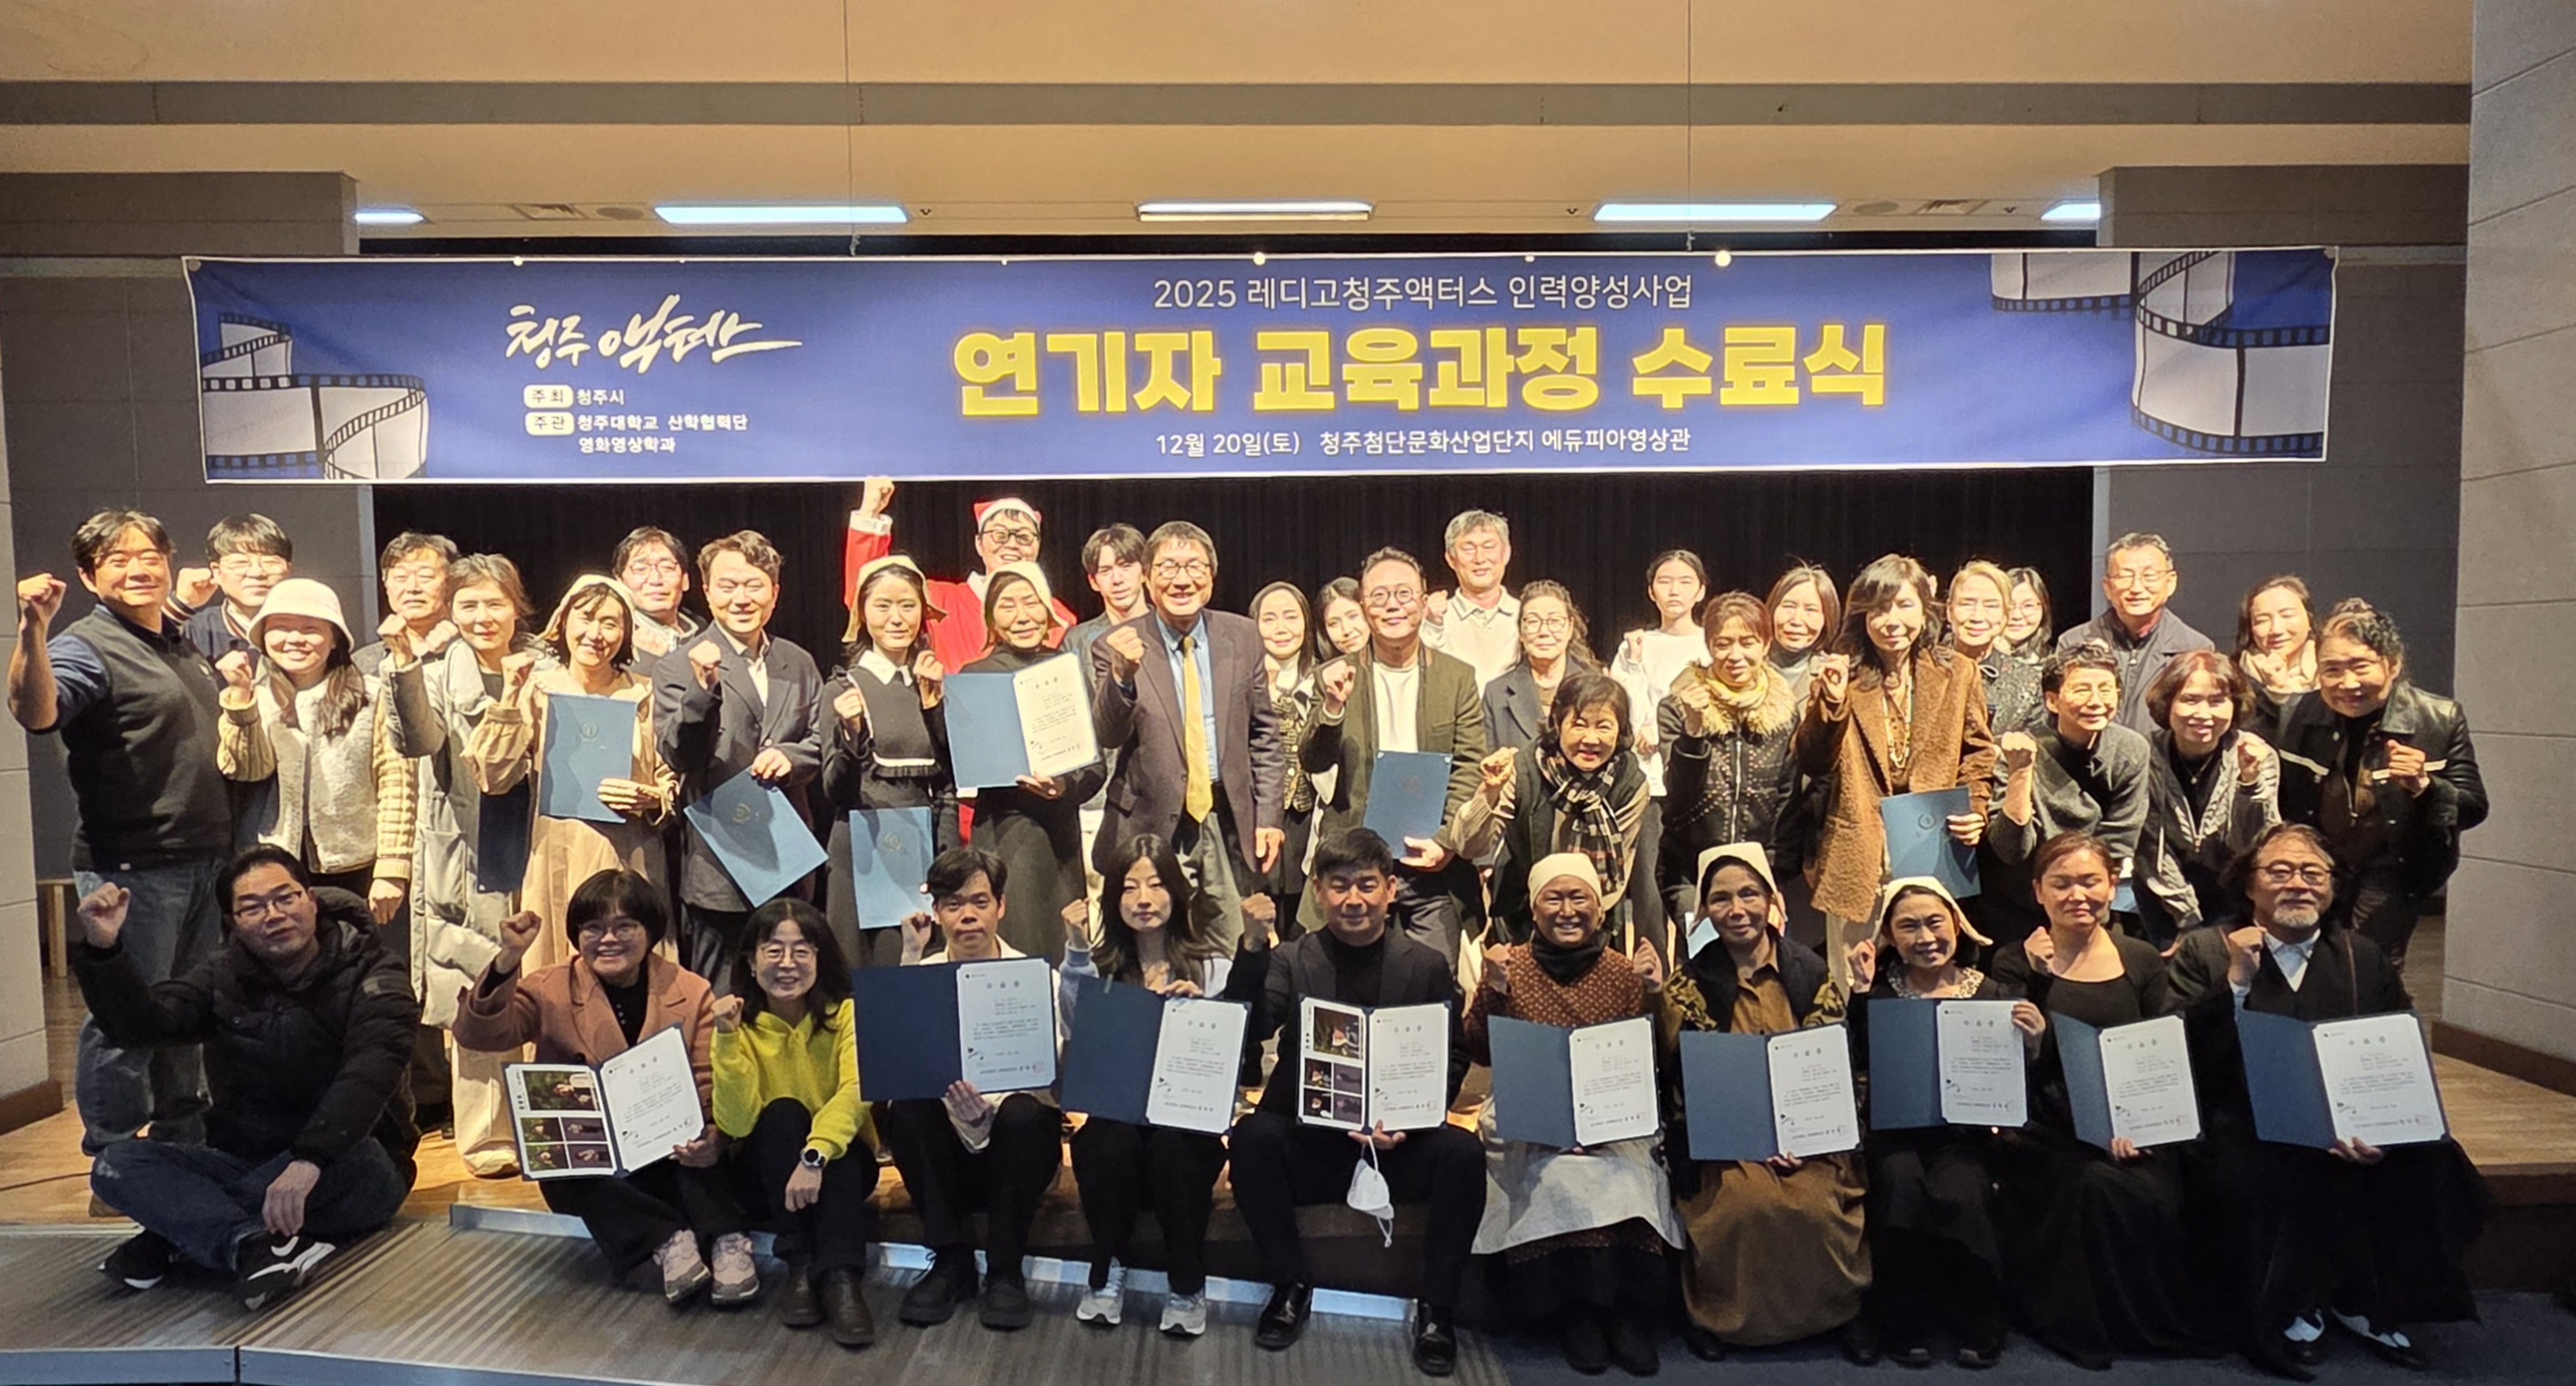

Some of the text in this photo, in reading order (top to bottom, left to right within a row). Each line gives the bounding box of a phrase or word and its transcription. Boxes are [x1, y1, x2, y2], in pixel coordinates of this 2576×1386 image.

[1154, 274, 1692, 310] 2025 레디고청주액터스 인력양성사업
[506, 305, 590, 369] 청주
[953, 324, 1885, 415] 연기자 교육과정 수료식
[576, 388, 625, 405] 청주시
[533, 414, 748, 431] 주관 청주대학교 산학협력단
[579, 436, 676, 453] 영화영상학과
[1156, 427, 1691, 457] 12월 20일(토) 청주첨단문화산업단지 에듀피아영상관
